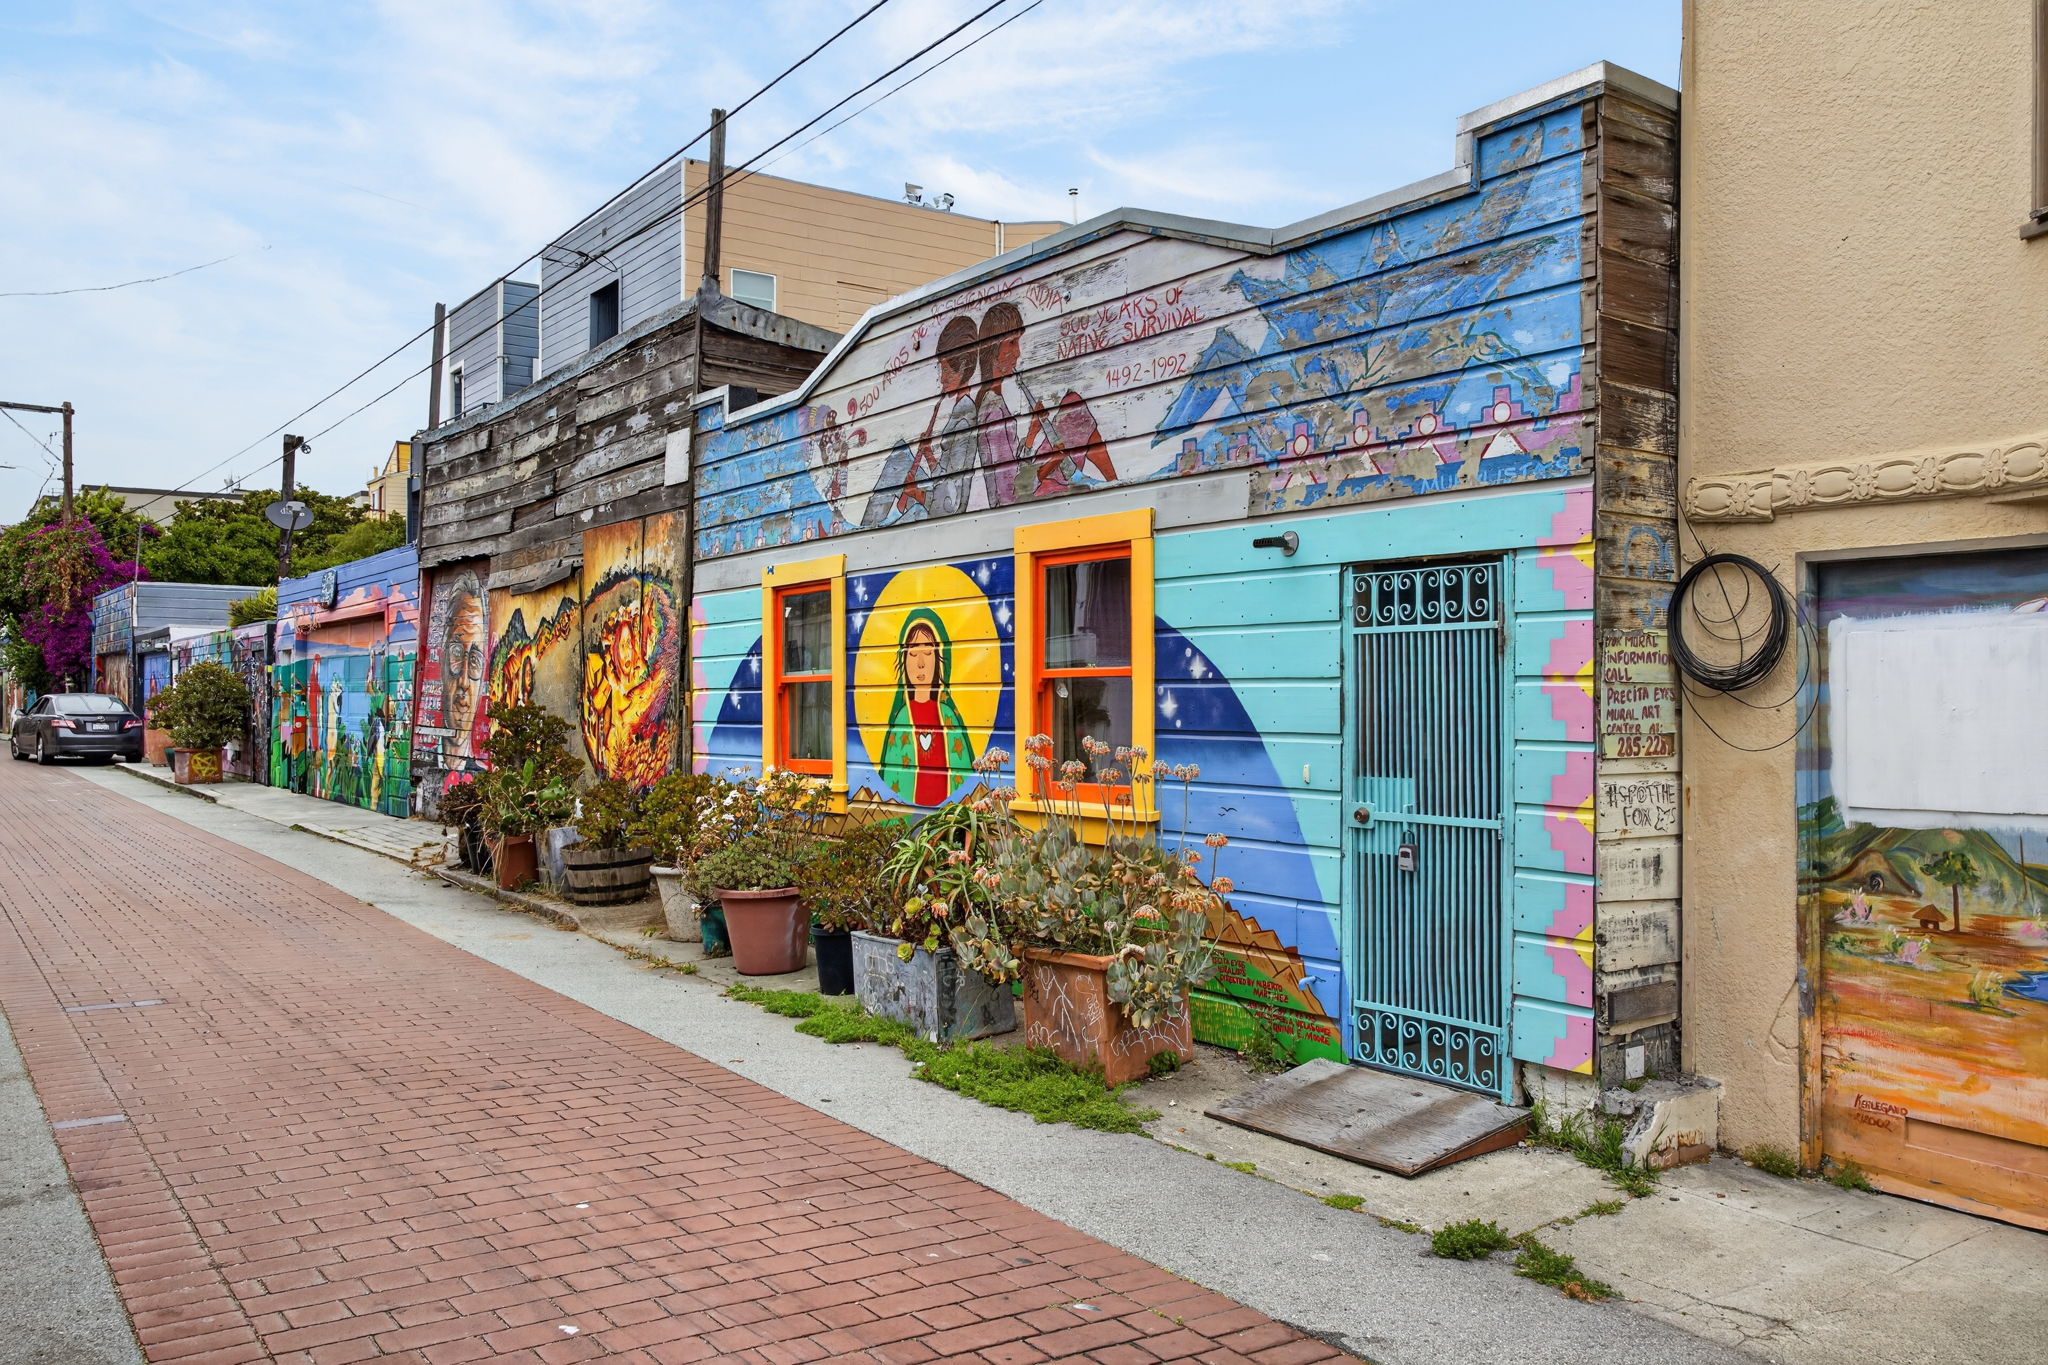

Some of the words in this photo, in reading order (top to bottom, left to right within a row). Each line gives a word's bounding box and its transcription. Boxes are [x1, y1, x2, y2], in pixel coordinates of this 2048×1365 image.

[1060, 314, 1090, 337] 500
[1097, 296, 1158, 327] YEARS
[1165, 281, 1188, 305] OF
[1056, 328, 1111, 360] NATIVE
[1121, 306, 1206, 342] SURVIVAL
[1105, 353, 1188, 389] 1492-1992
[860, 386, 880, 416] 500
[1605, 667, 1632, 682] CALL
[1606, 708, 1639, 721] MURAL
[1641, 705, 1660, 720] ART
